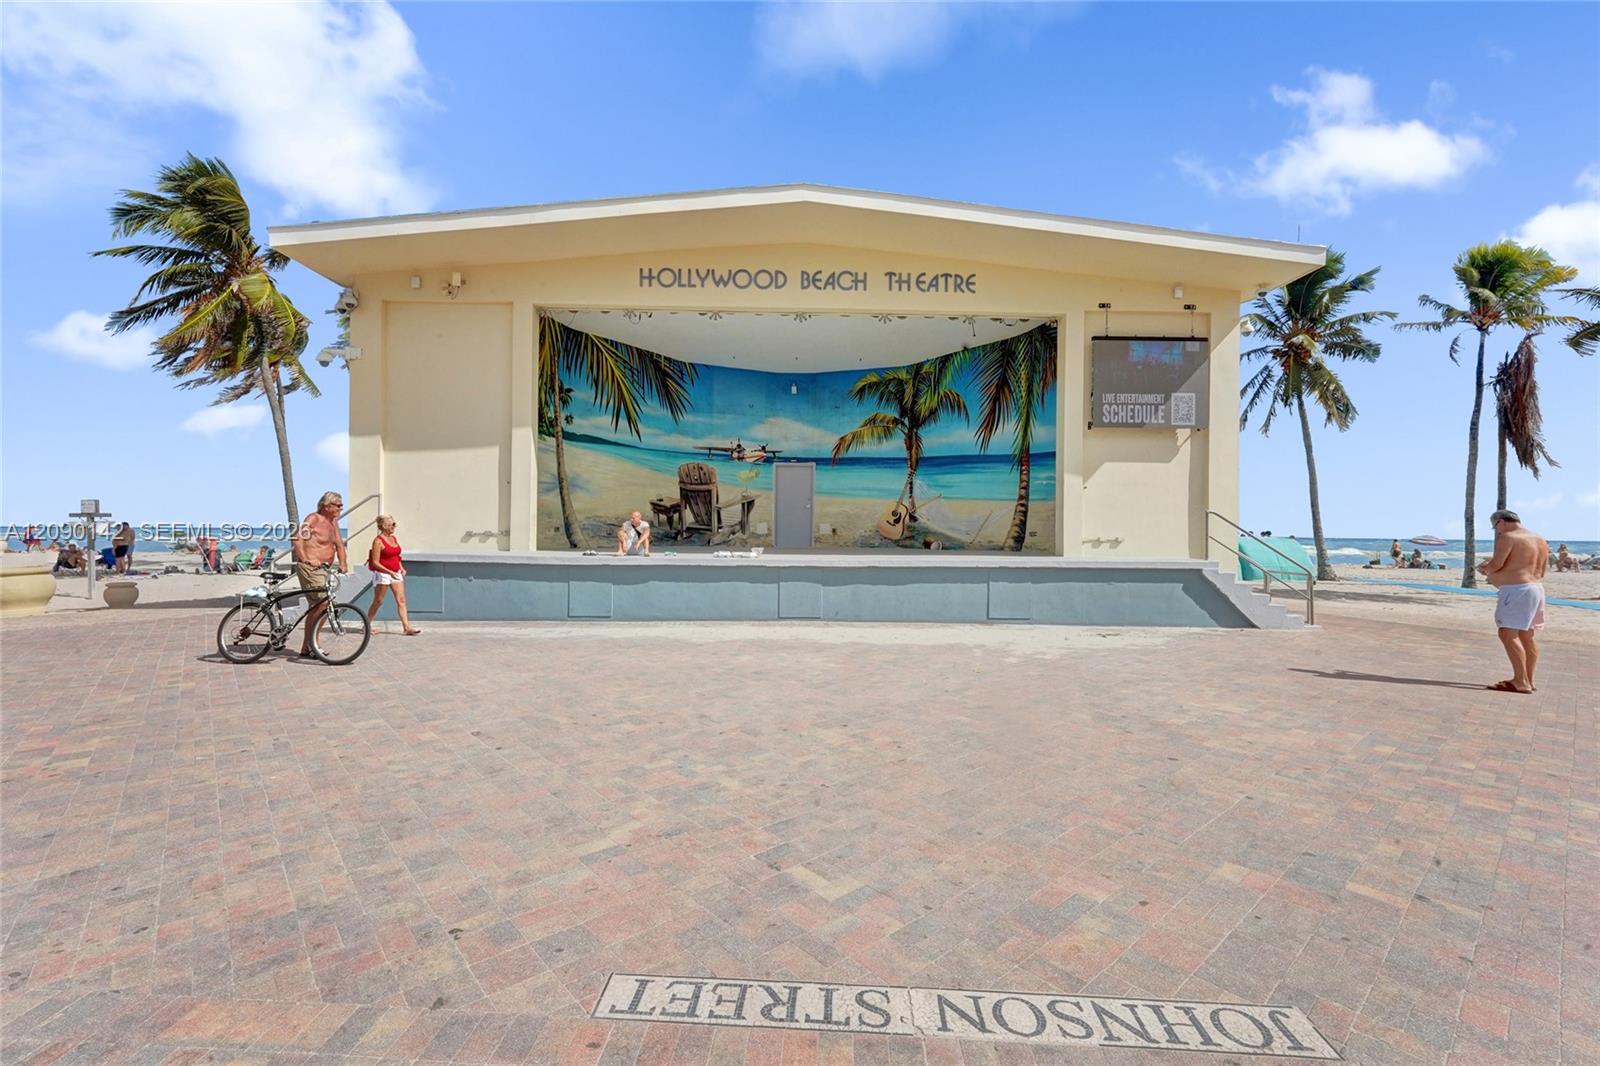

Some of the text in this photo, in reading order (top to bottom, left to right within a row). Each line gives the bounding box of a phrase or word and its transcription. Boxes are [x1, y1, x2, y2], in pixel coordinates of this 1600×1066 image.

[639, 267, 976, 294] HOLLYWOOD BEACH THEATRE
[1102, 393, 1165, 404] LIVE ENTERTAINMENT
[1102, 404, 1165, 424] SCHEDULE
[608, 978, 1316, 1052] JOHNSON STREET
